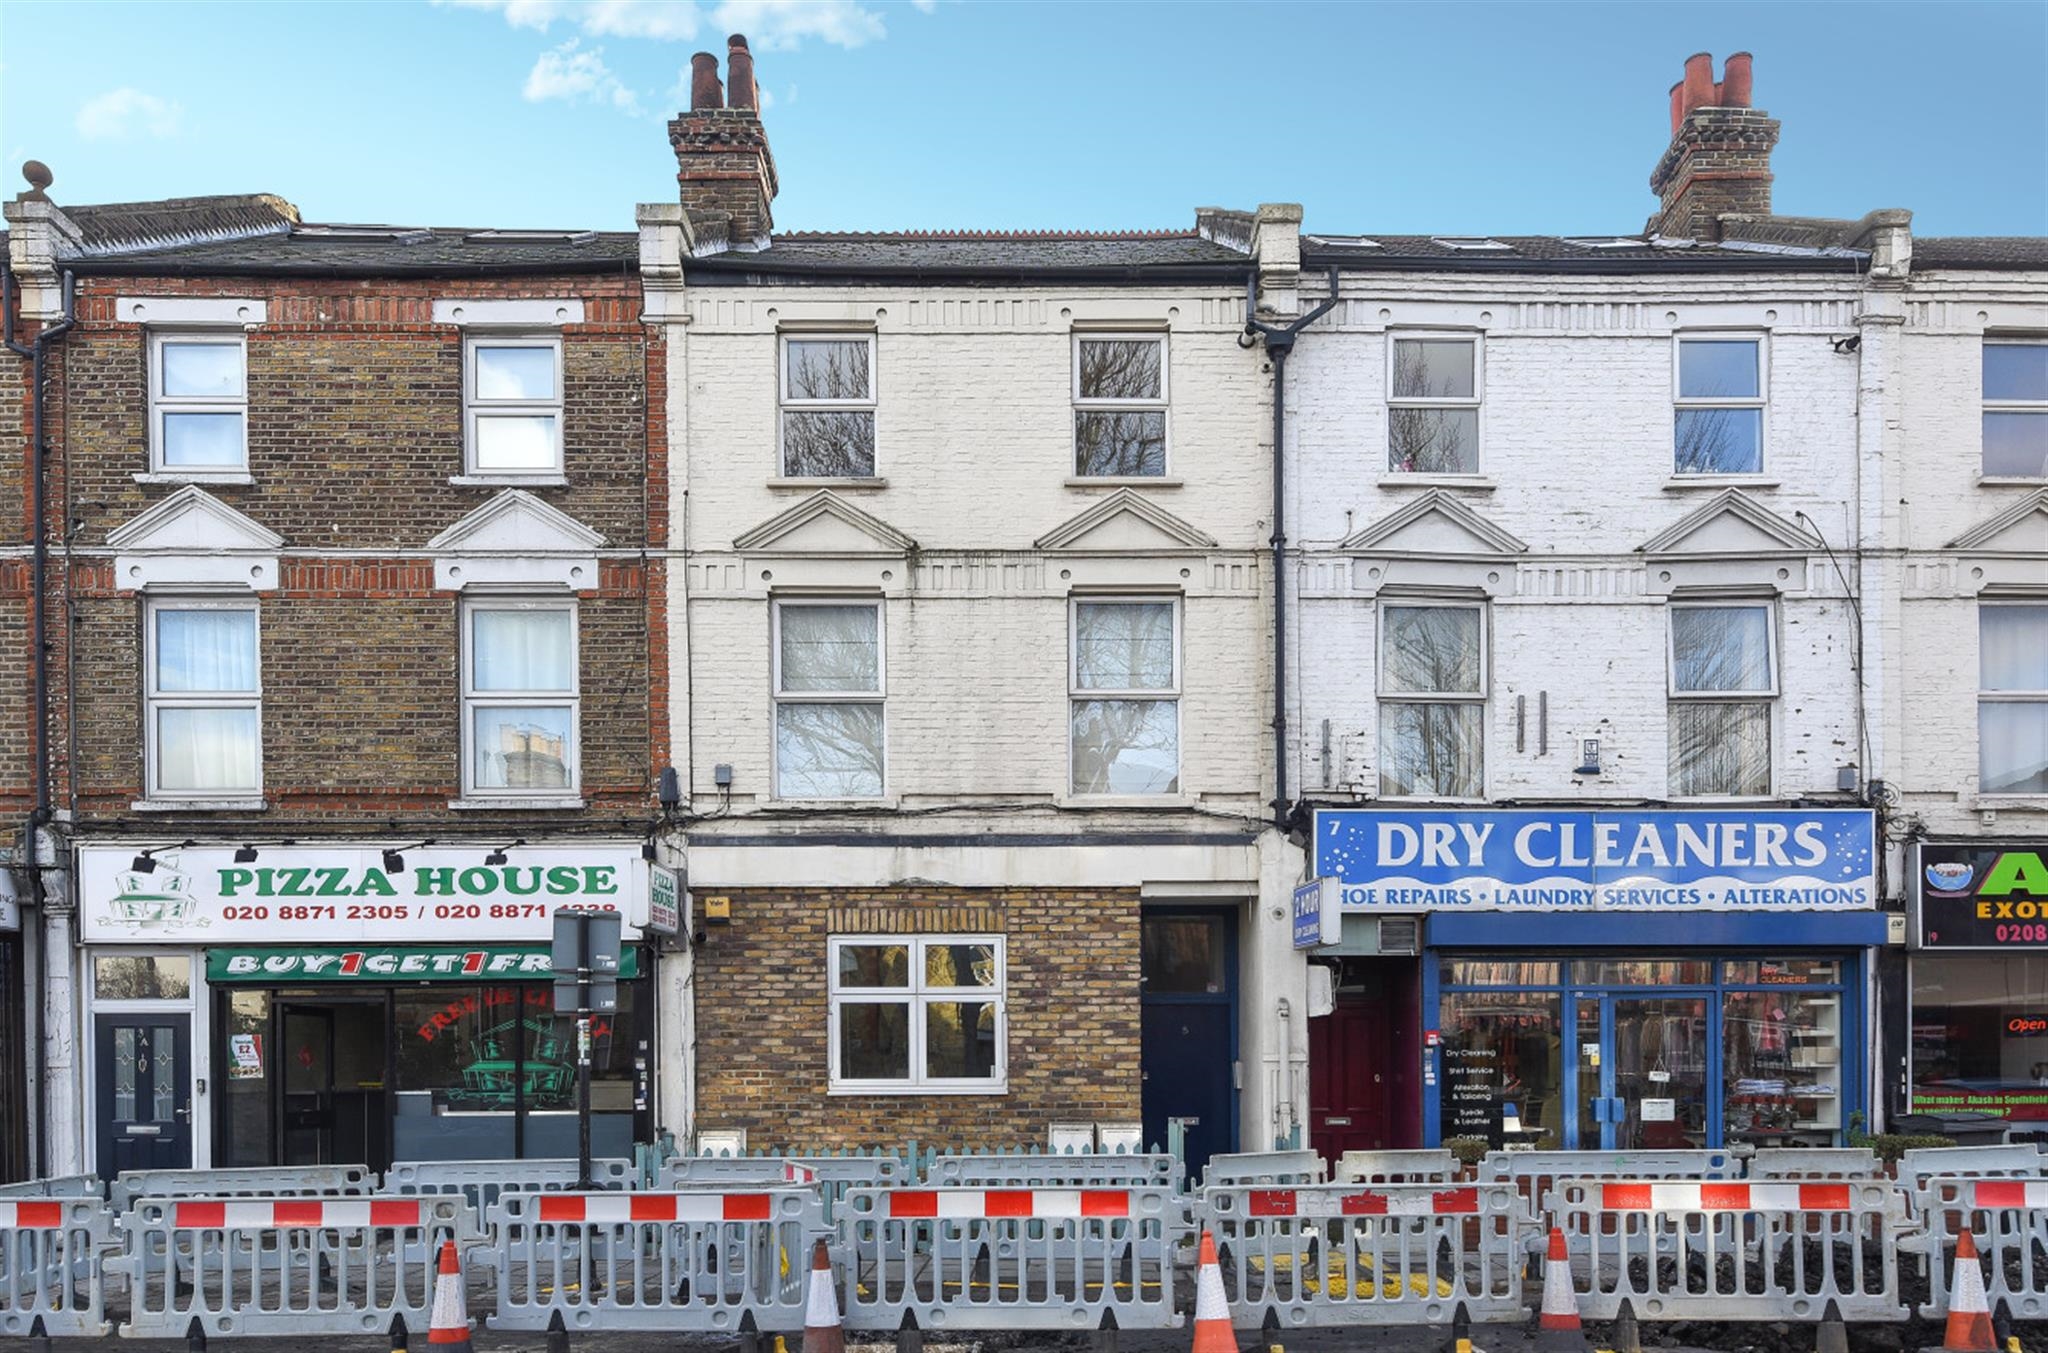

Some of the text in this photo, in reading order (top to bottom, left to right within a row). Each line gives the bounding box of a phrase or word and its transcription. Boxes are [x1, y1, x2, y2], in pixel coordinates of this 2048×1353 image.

[1329, 820, 1827, 868] 7 DRY CLEANERS
[217, 866, 618, 896] PIZZA HOUSE
[653, 871, 674, 893] PIZZA
[652, 887, 675, 909] HOUSE
[1341, 887, 1867, 906] OE REPAIRS LAUNDRY SERVICES ALTERATIONS
[223, 905, 269, 920] 020
[279, 905, 336, 920] 8871
[346, 905, 409, 920] 2305
[435, 904, 481, 919] 020
[489, 904, 546, 919] 8871
[1930, 923, 2048, 942] 9 0208
[2008, 1018, 2046, 1032] Open
[1446, 1049, 1497, 1058] Dry Cleaning
[1461, 1093, 1492, 1101] Tailoring
[1913, 1095, 1935, 1104] What
[1935, 1095, 1965, 1104] makes
[1459, 1109, 1484, 1117] Suede
